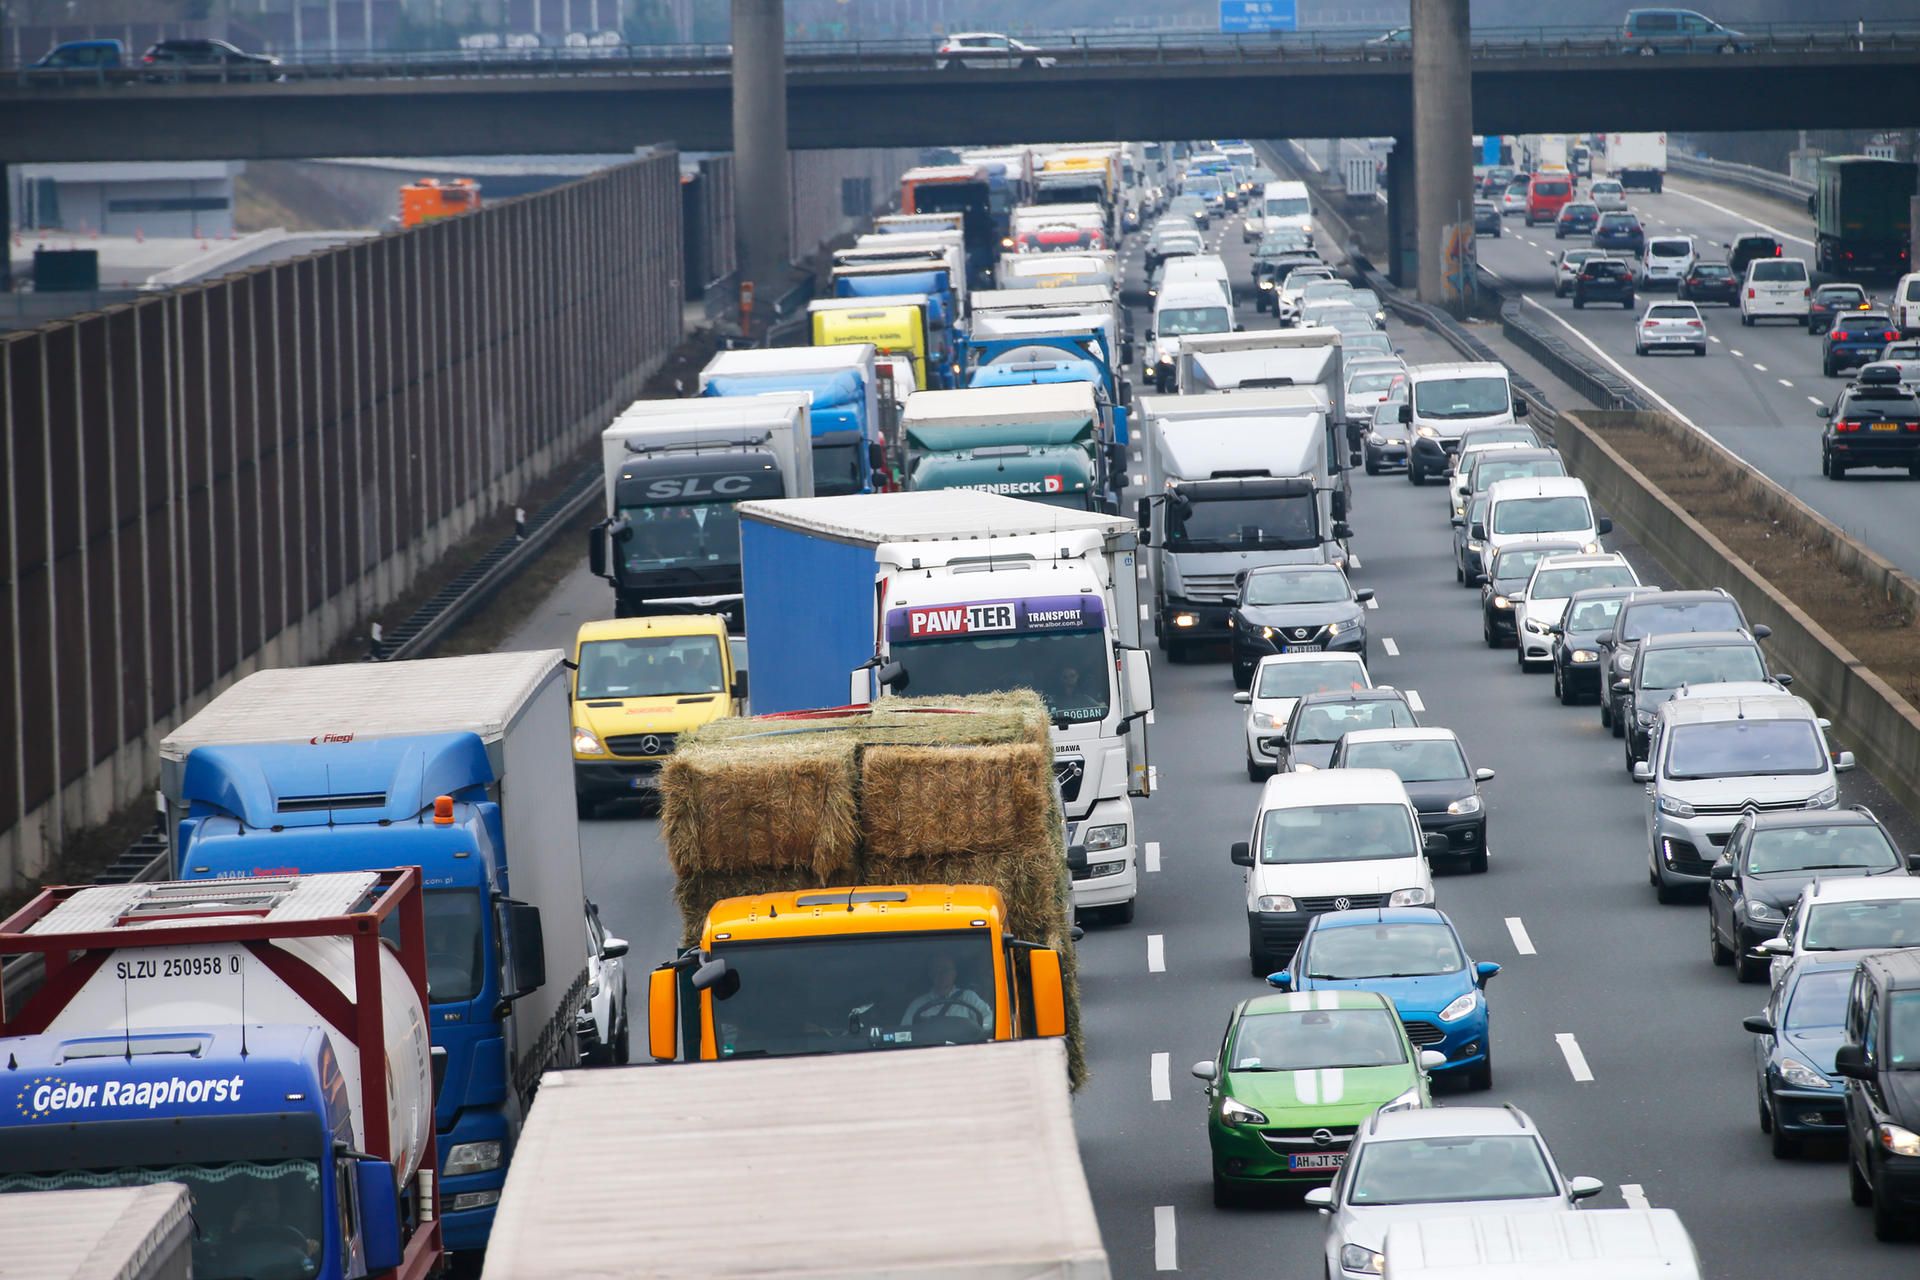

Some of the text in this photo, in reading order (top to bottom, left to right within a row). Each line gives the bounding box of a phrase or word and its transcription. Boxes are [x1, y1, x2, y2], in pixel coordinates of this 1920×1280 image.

[645, 475, 753, 499] SLC
[912, 605, 1012, 634] PAW-TER
[1028, 609, 1081, 623] TRANSPORT
[1028, 618, 1084, 629] www.albor.com.pl
[1063, 708, 1102, 719] BOGDAN
[323, 732, 354, 744] Fliegl
[117, 956, 240, 980] SLZU 250958 0
[33, 1074, 244, 1111] Gebr. Raaphorst
[1296, 1155, 1310, 1167] AH
[1316, 1155, 1330, 1167] JT
